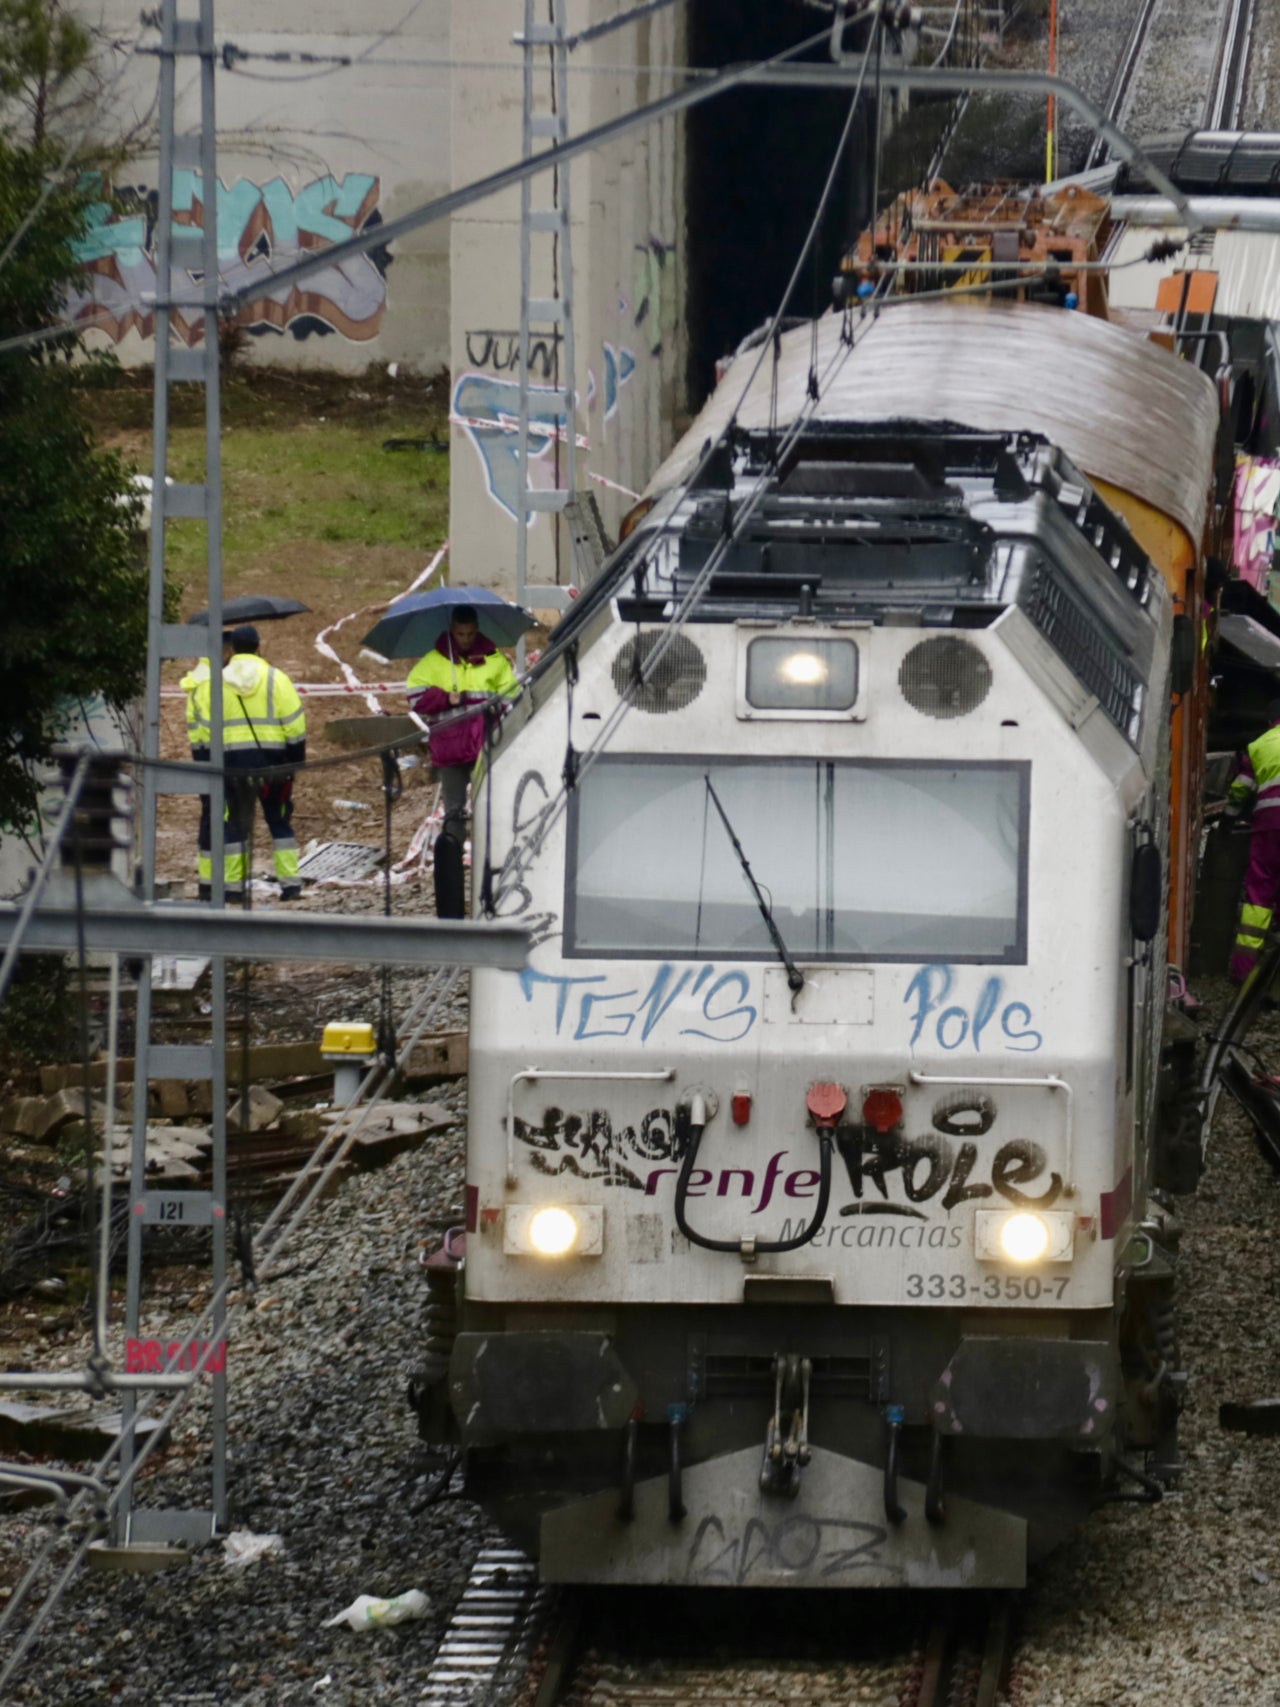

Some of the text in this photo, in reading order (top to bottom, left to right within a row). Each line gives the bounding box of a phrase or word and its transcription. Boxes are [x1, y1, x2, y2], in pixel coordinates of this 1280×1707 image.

[644, 1150, 822, 1214] renfe
[159, 1202, 184, 1220] 121
[906, 1274, 1071, 1300] 333-350-7
